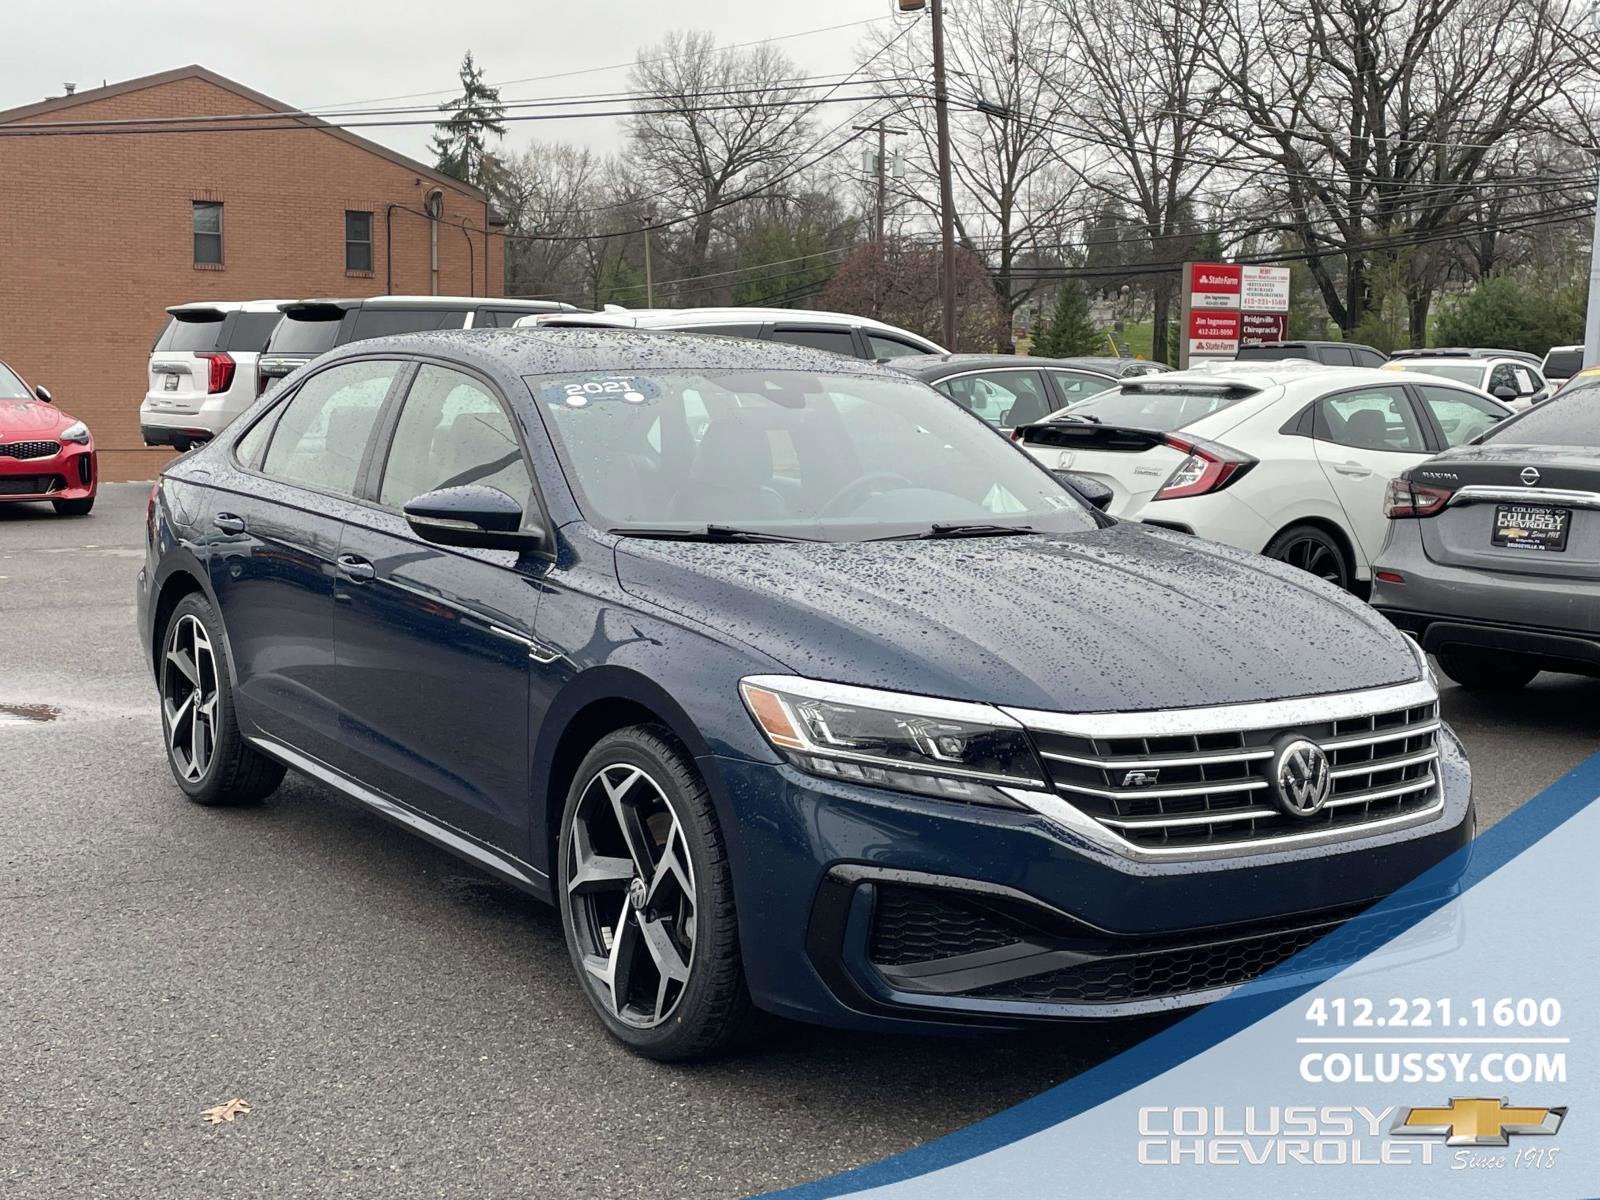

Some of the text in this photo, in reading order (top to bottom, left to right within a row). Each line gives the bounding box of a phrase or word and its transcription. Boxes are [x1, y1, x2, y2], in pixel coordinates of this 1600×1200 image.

[1243, 315, 1274, 324] Bridgeville
[1243, 325, 1279, 335] Chiropractic
[564, 381, 637, 396] 2021
[1422, 471, 1459, 480] MAXIMA
[1512, 506, 1552, 514] COLUSSY
[1497, 511, 1566, 525] COLUSSY
[1497, 519, 1564, 531] CHEVROLET
